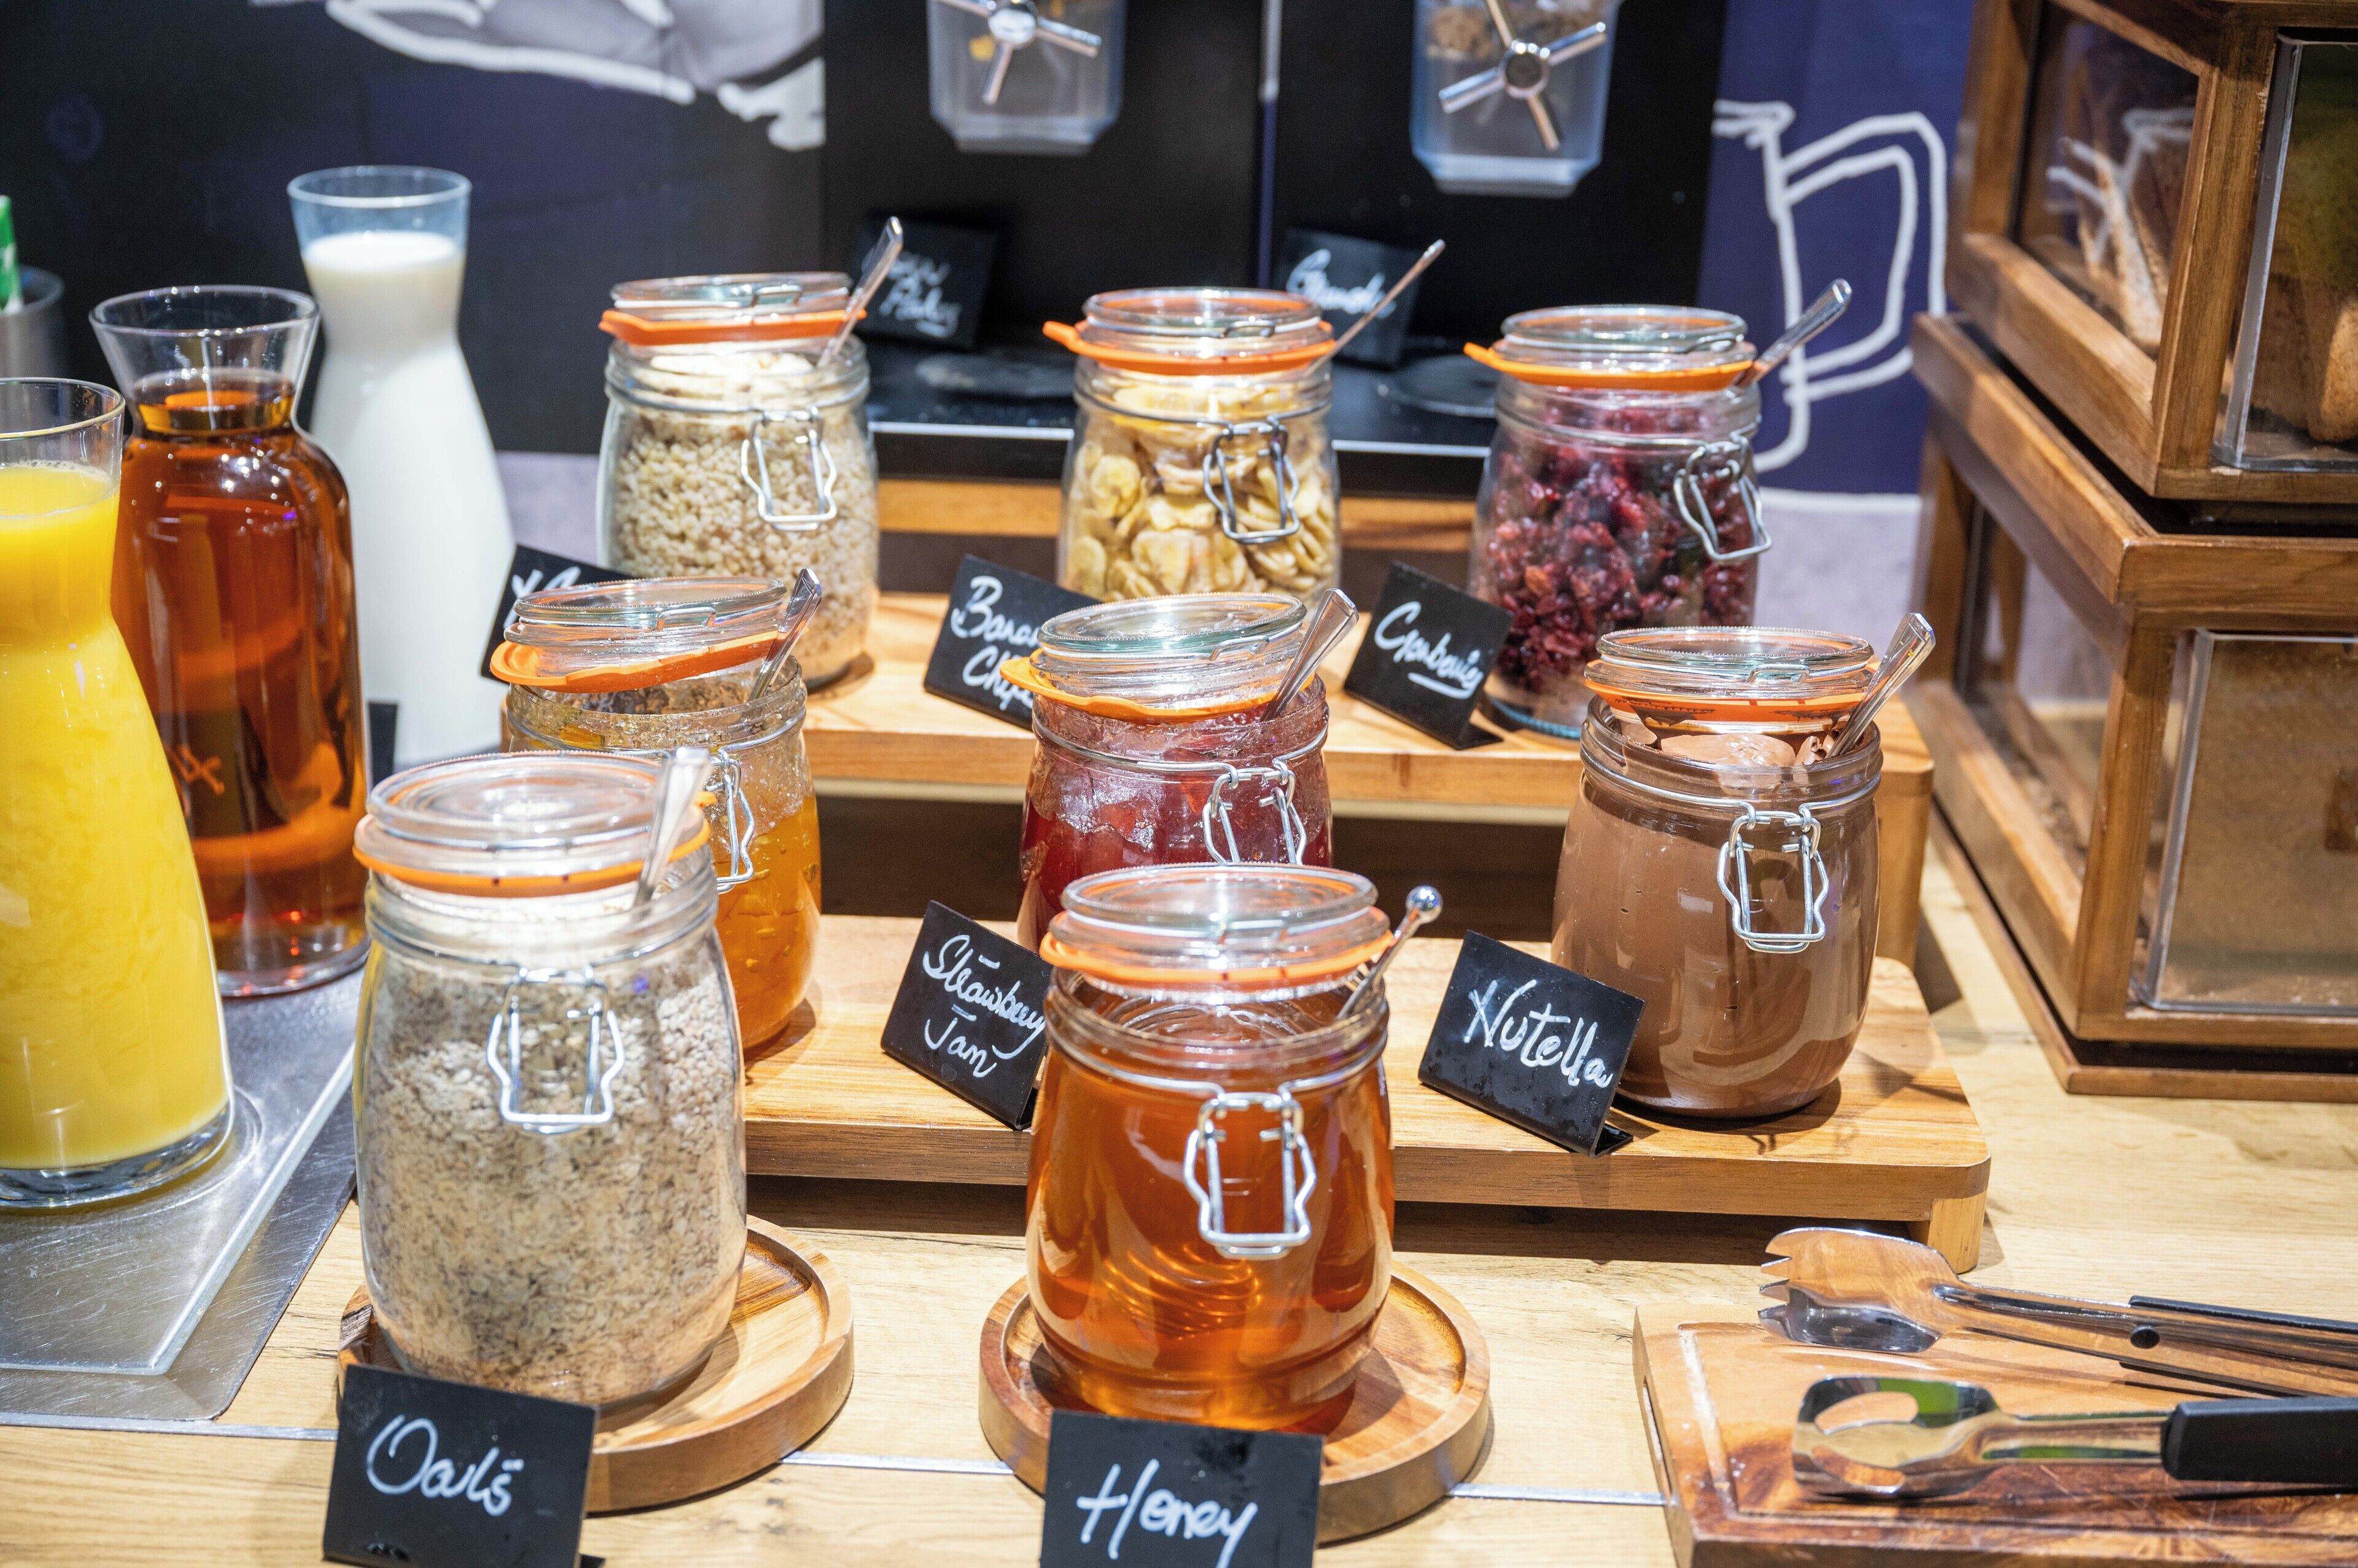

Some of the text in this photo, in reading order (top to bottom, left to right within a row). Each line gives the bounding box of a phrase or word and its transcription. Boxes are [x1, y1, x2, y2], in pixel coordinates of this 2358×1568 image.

[951, 575, 1041, 646] Bana
[923, 934, 1046, 1060] Strawberry
[924, 1003, 997, 1078] Jam
[1463, 980, 1614, 1089] Nutella
[367, 1415, 524, 1516] Oats
[1076, 1458, 1258, 1568] Honey
